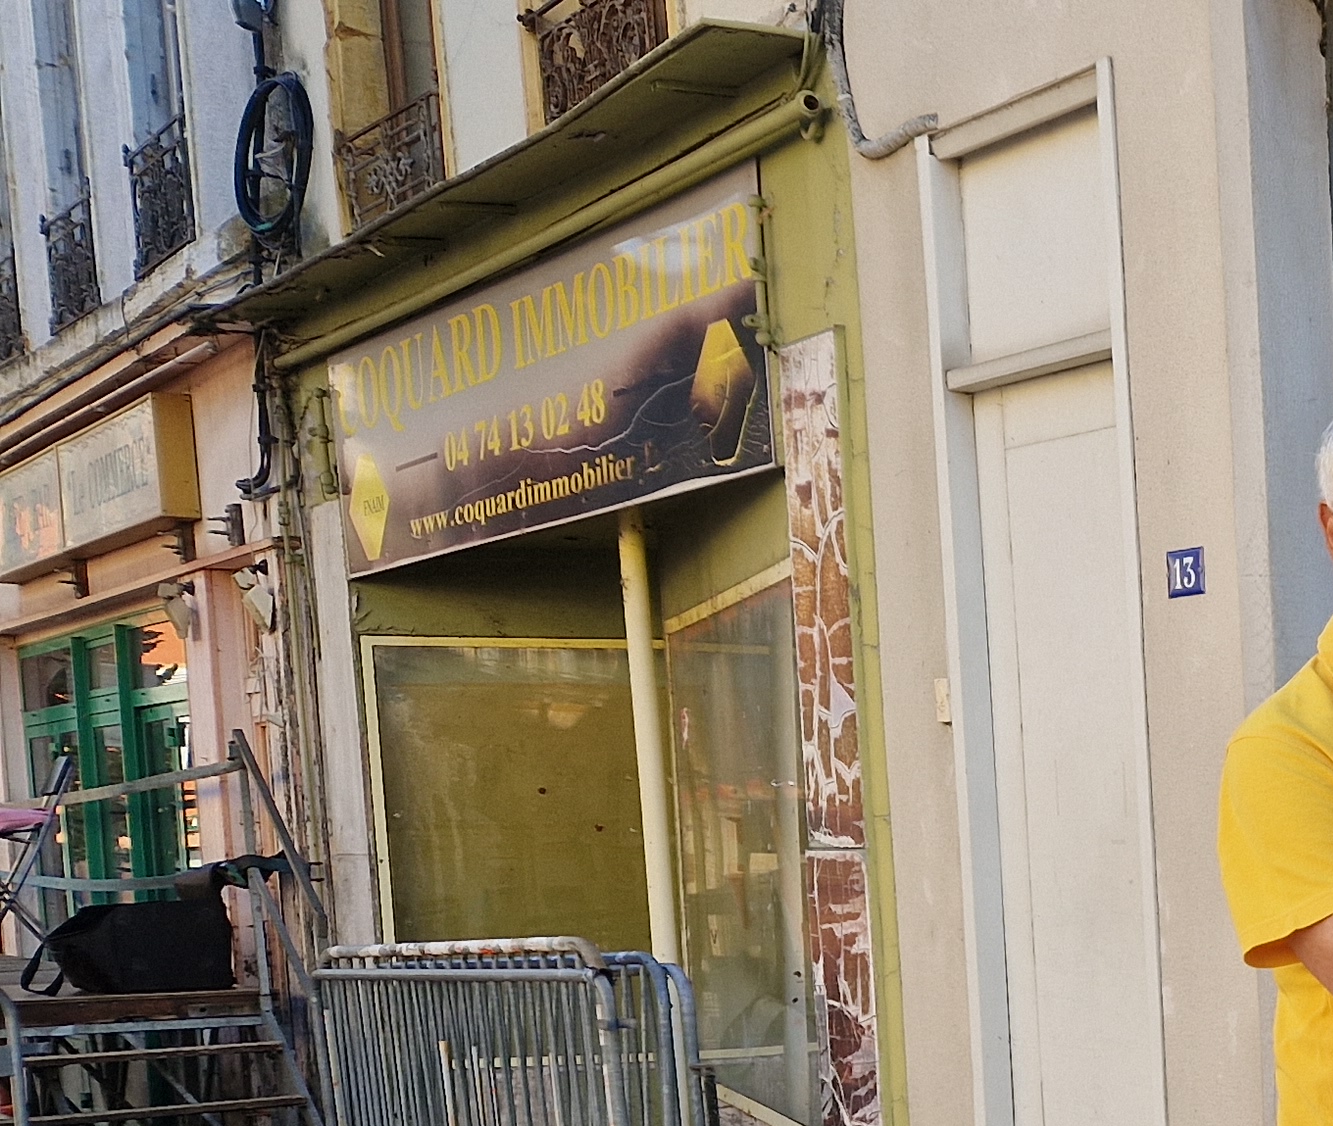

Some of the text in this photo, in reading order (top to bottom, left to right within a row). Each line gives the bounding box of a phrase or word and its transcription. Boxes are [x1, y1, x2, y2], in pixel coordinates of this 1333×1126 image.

[337, 202, 753, 436] COQUARD IMMOBILIER
[443, 379, 606, 472] 04 74 13 02 48
[1173, 556, 1196, 590] 13
